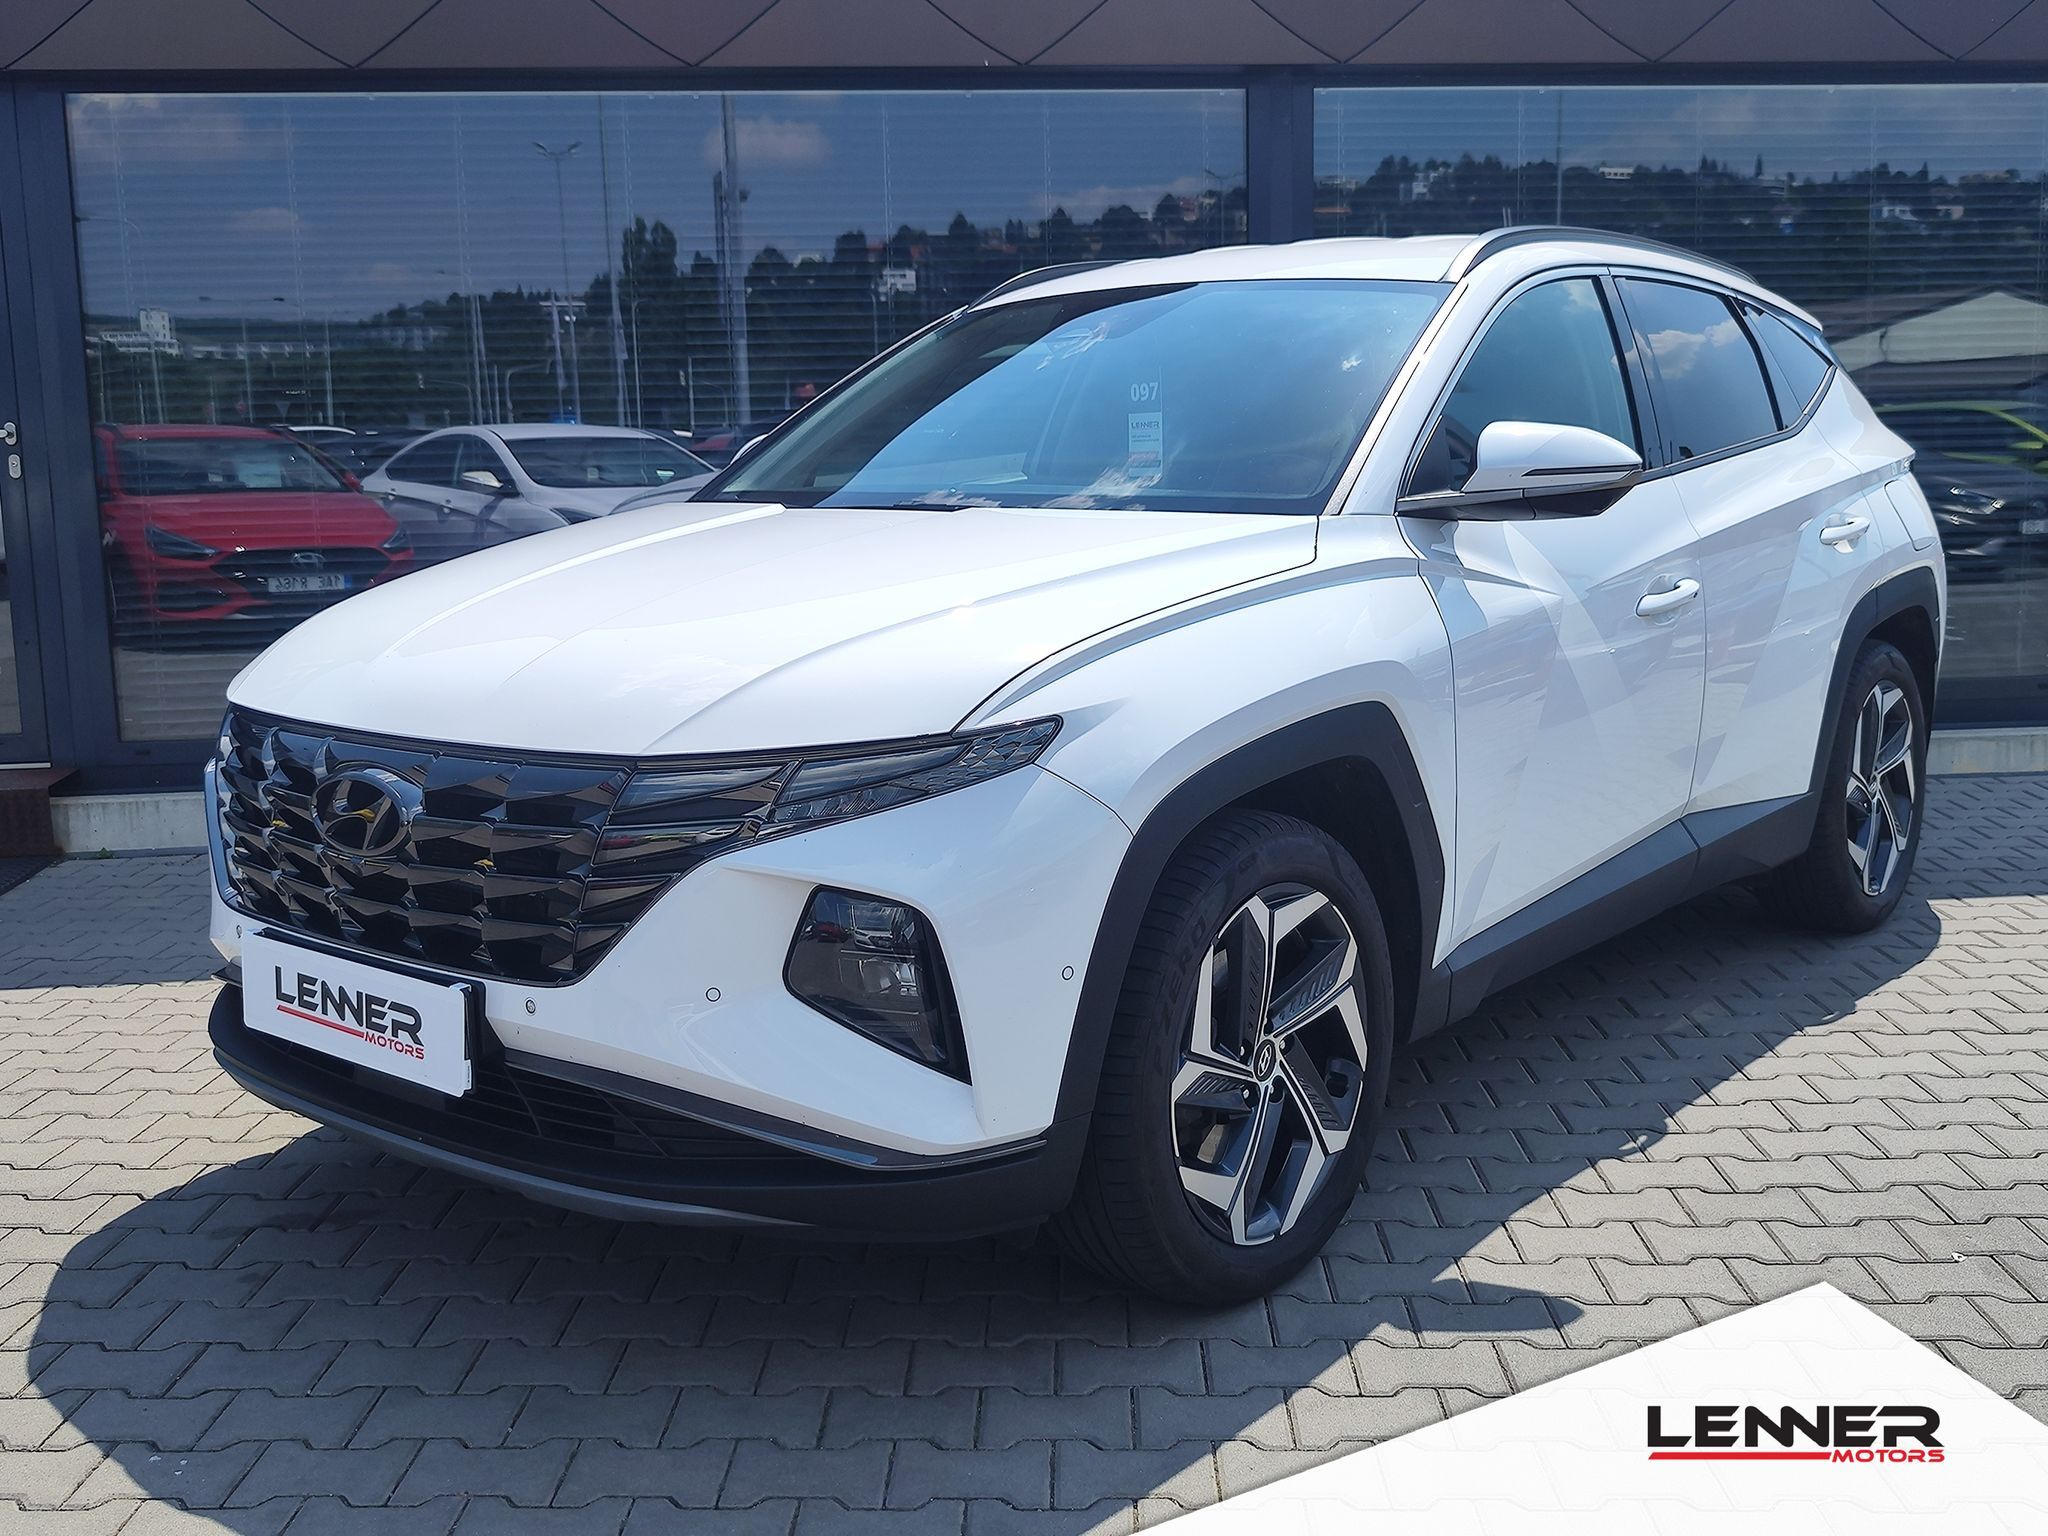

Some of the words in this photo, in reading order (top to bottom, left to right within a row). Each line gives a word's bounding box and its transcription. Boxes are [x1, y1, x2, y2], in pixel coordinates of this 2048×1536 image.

[1131, 382, 1158, 402] 097
[274, 965, 425, 1047] LENNER
[364, 1031, 425, 1060] MOTORS
